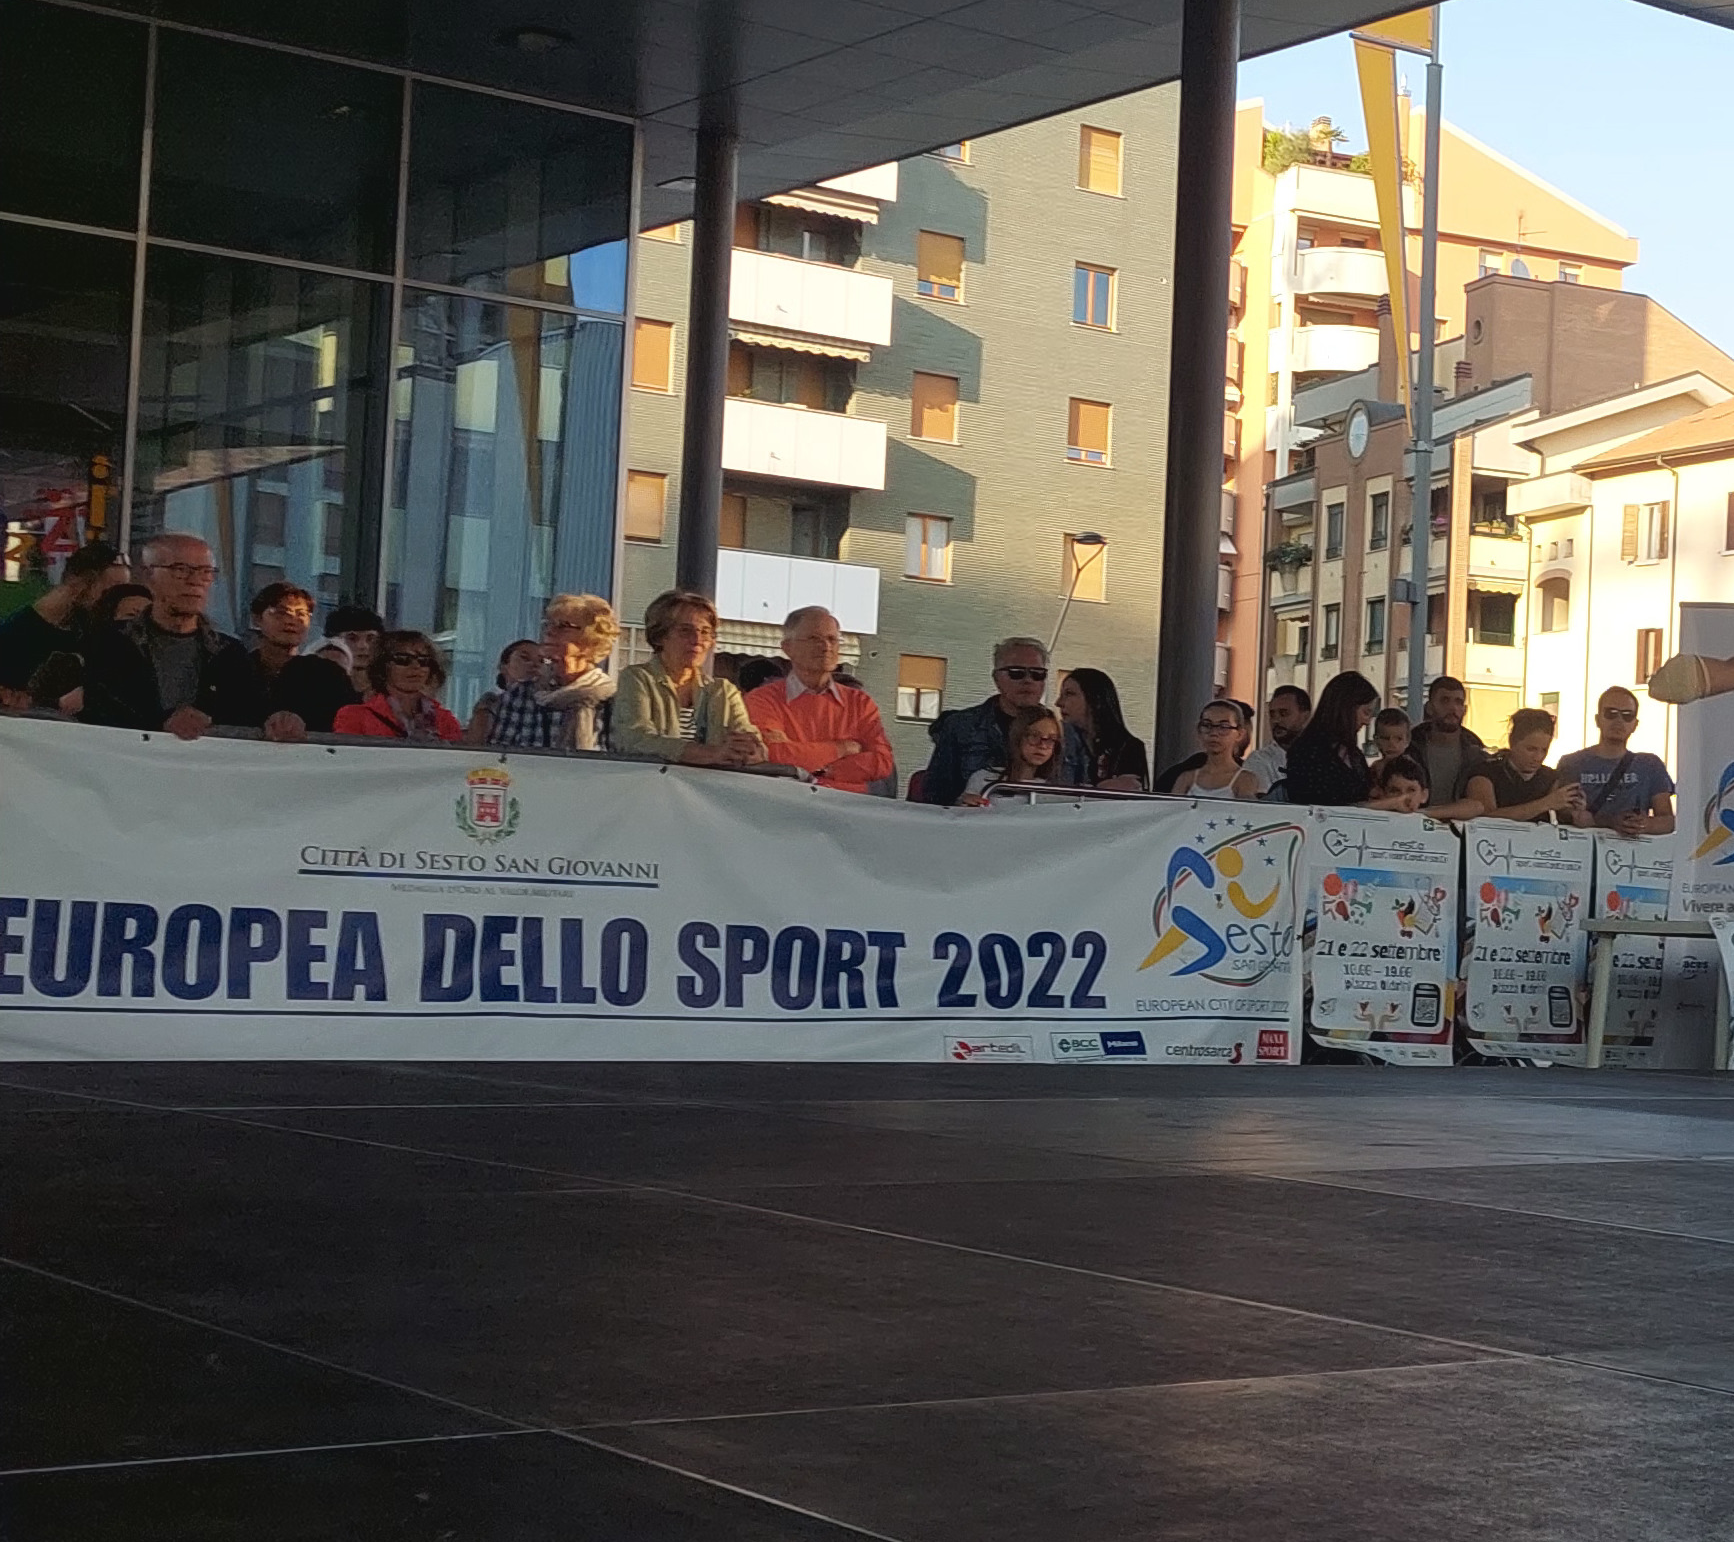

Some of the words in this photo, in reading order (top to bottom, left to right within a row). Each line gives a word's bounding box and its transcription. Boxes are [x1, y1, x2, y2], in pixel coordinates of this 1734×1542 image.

[300, 845, 370, 869] CITTÀ
[379, 852, 405, 869] DI
[416, 851, 486, 872] SESTO
[495, 854, 538, 874] SAN
[548, 856, 659, 879] GIOVANNI
[1682, 899, 1724, 911] Vivere
[1725, 902, 1734, 913] a
[0, 897, 388, 1002] EUROPEA
[421, 913, 649, 1007] DELLO
[677, 921, 906, 1010] SPORT
[933, 930, 1107, 1009] 2022
[1316, 940, 1334, 956] 21
[1338, 942, 1347, 956] e
[1371, 944, 1441, 960] settembre
[1474, 945, 1488, 961] 21
[1490, 948, 1497, 962] e
[1136, 998, 1206, 1012] EUROPEAN
[1209, 998, 1234, 1011] CITY
[1072, 1039, 1098, 1048] BCC
[1258, 1046, 1287, 1057] SPORT
